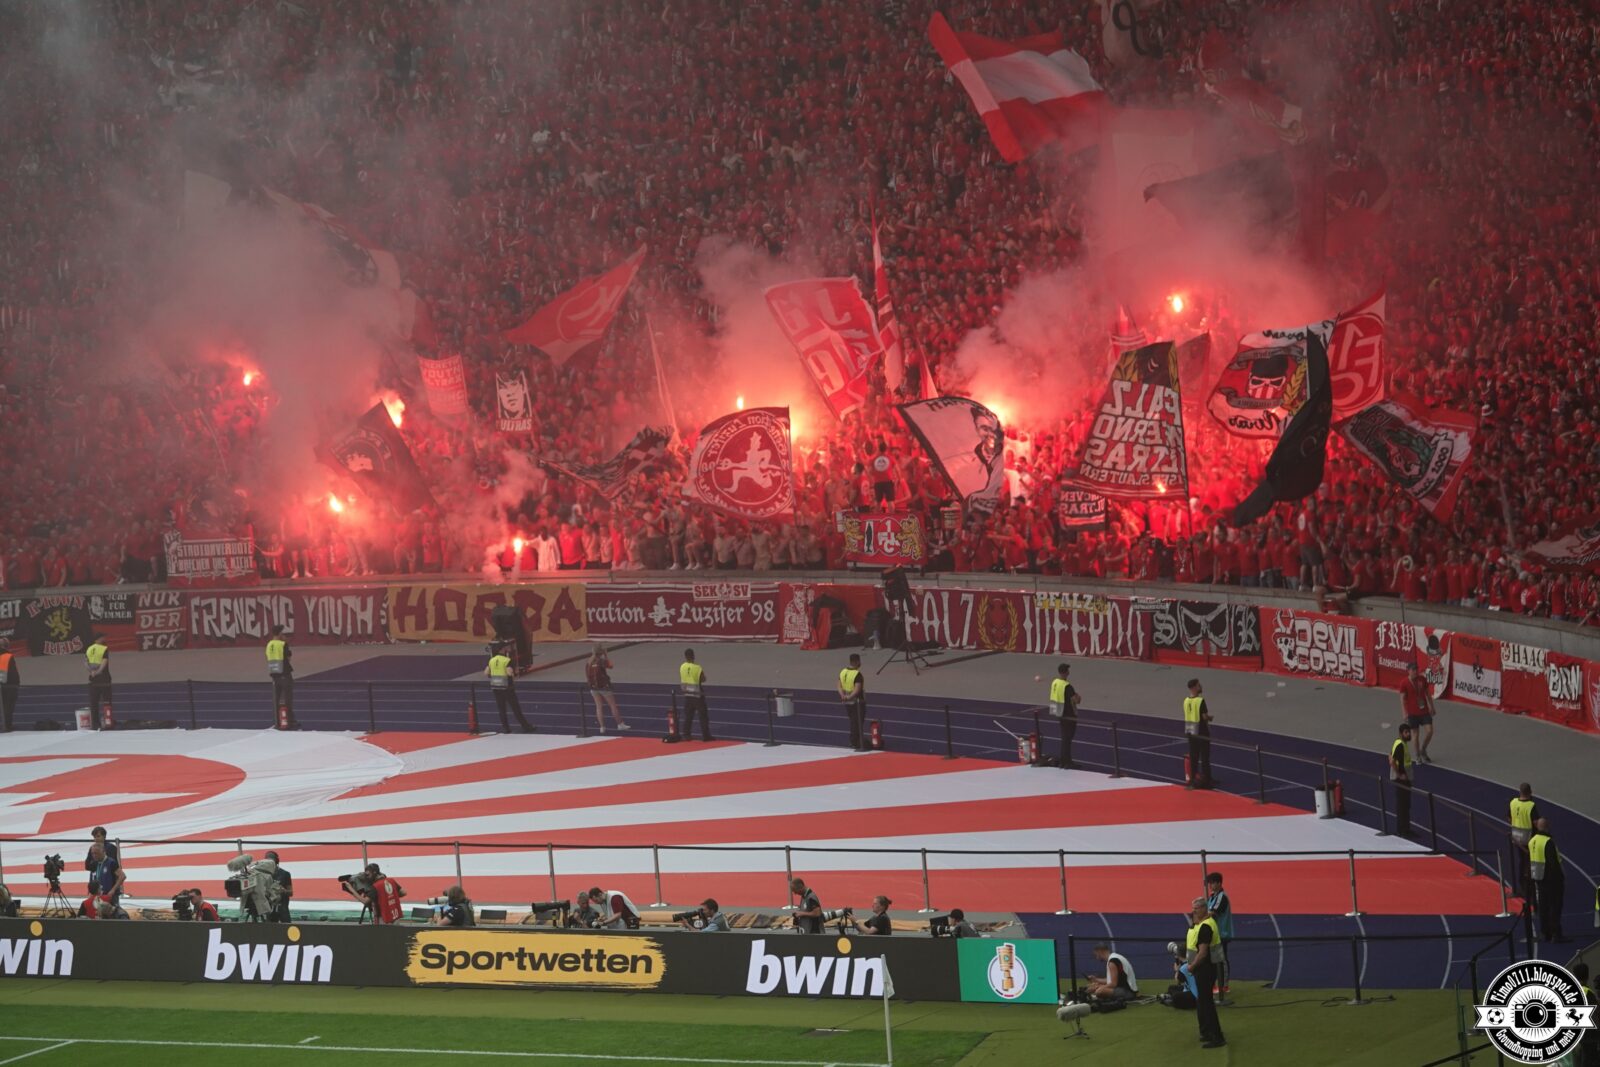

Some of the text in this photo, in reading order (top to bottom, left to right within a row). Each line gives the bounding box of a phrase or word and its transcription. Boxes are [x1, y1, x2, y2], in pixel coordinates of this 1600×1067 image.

[500, 419, 532, 431] ULTRAS
[138, 591, 180, 607] NUR
[694, 584, 750, 598] SEK SV
[1035, 591, 1094, 608] PFALZ
[109, 601, 126, 610] FÜR
[105, 610, 133, 619] IMMER
[140, 612, 181, 629] DER
[190, 595, 294, 639] FRENETIC
[302, 595, 374, 637] YOUTH
[678, 601, 744, 628] Luzifer
[142, 633, 181, 650] FCK
[1296, 647, 1365, 681] CORPS
[204, 926, 334, 982] bwin
[419, 942, 652, 983] Sportwetten
[745, 936, 884, 997] bwin
